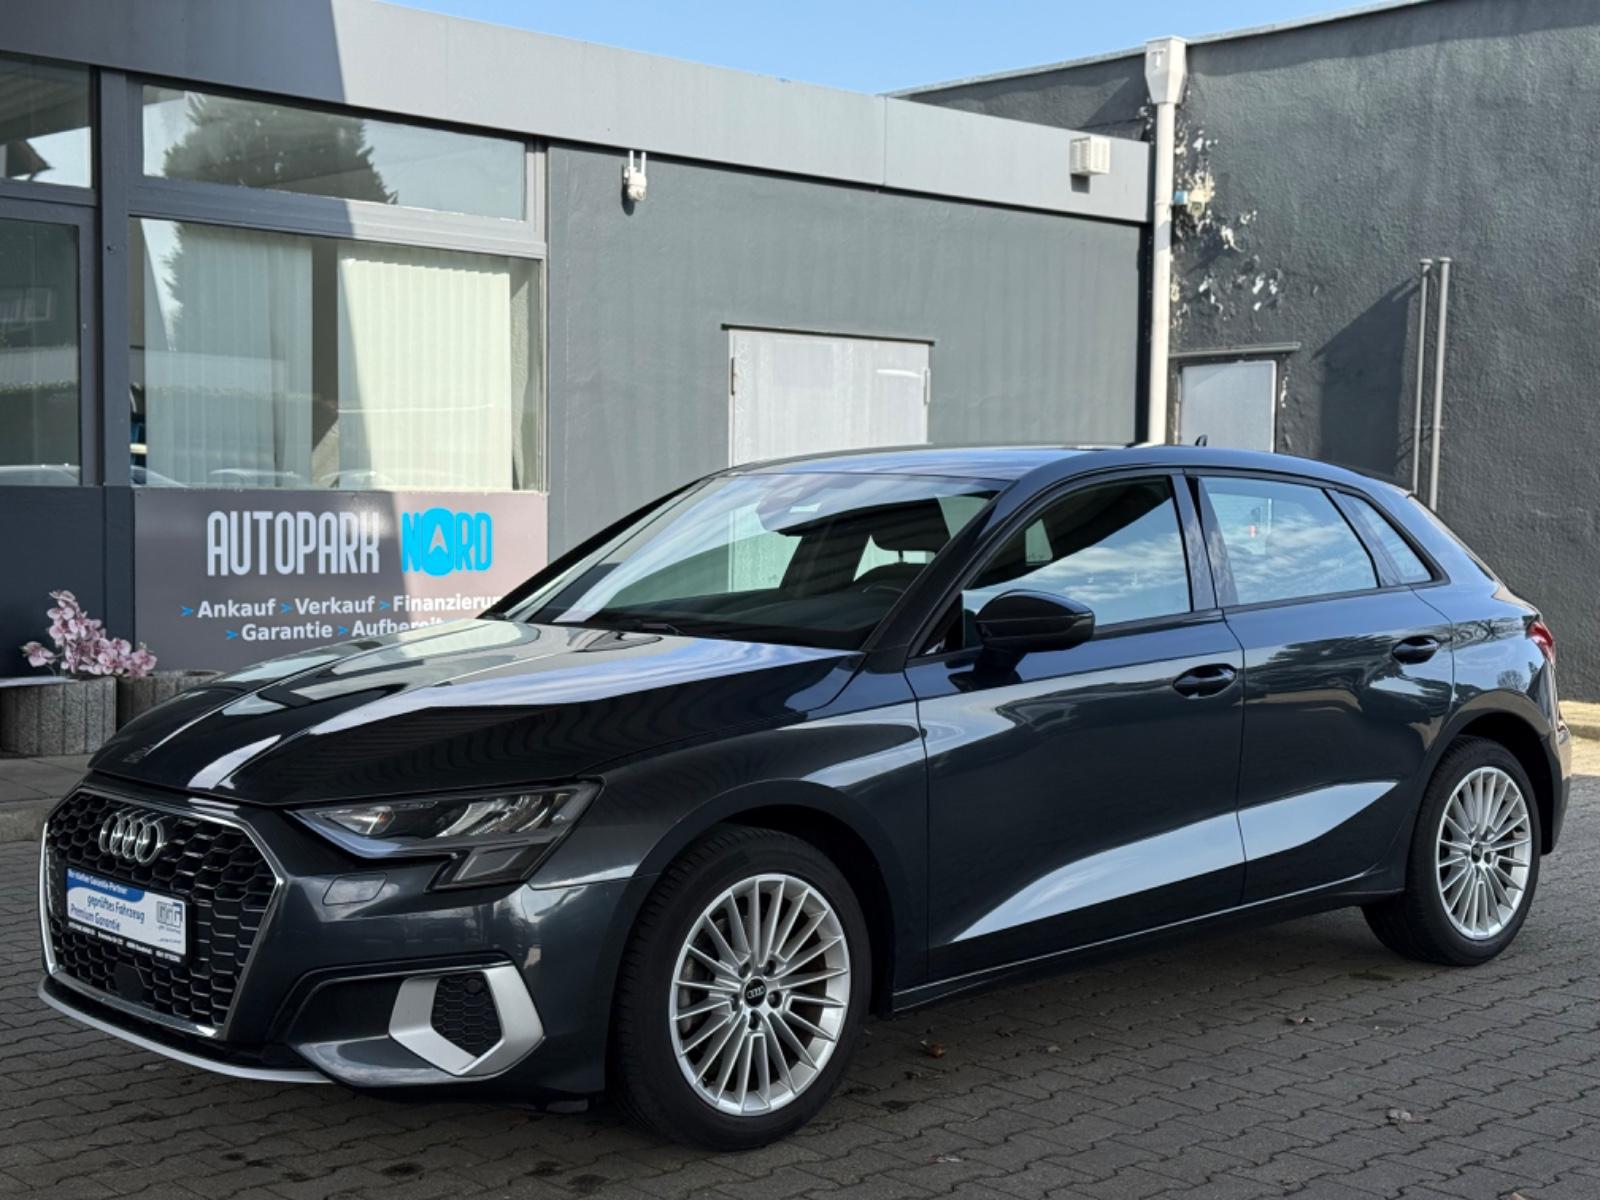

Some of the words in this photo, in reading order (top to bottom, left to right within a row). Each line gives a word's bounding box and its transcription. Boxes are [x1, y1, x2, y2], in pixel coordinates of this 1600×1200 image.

[207, 511, 380, 577] AUTOPARK
[401, 507, 493, 577] NORD
[197, 599, 277, 618] Ankauf
[294, 596, 376, 616] Verkauf
[393, 593, 503, 613] Finanzieru
[241, 620, 333, 641] Garantie
[70, 903, 95, 922] Premium
[95, 912, 120, 931] Garantie
[115, 901, 145, 924] Fahrzeug
